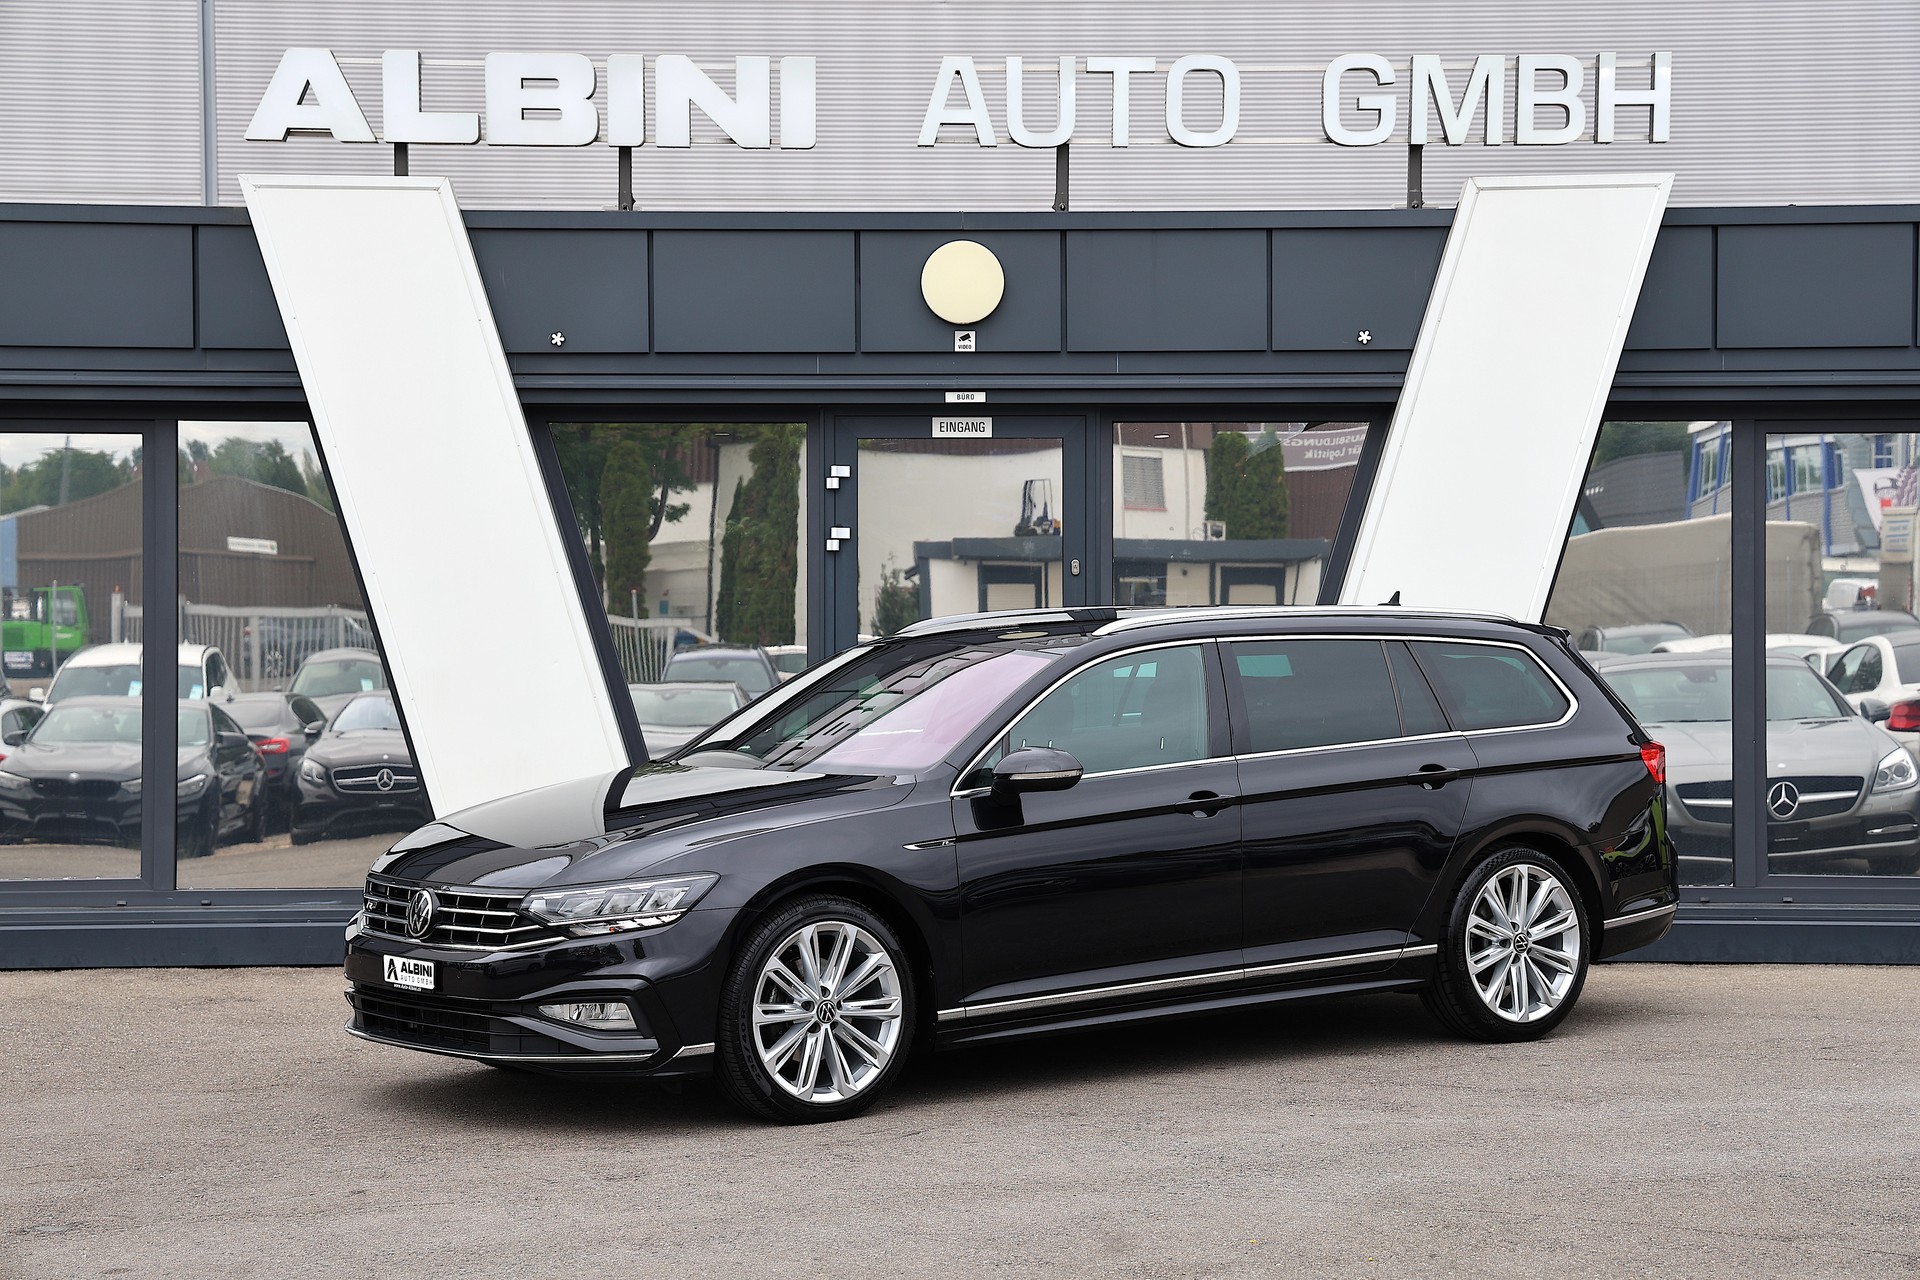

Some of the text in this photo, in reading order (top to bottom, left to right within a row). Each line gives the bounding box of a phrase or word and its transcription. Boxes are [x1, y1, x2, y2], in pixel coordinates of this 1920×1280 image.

[245, 48, 1671, 149] ALBINI AUTO GMBH
[940, 421, 986, 433] EINGANG
[401, 961, 432, 978] ALBINI
[401, 975, 415, 983] AUTO
